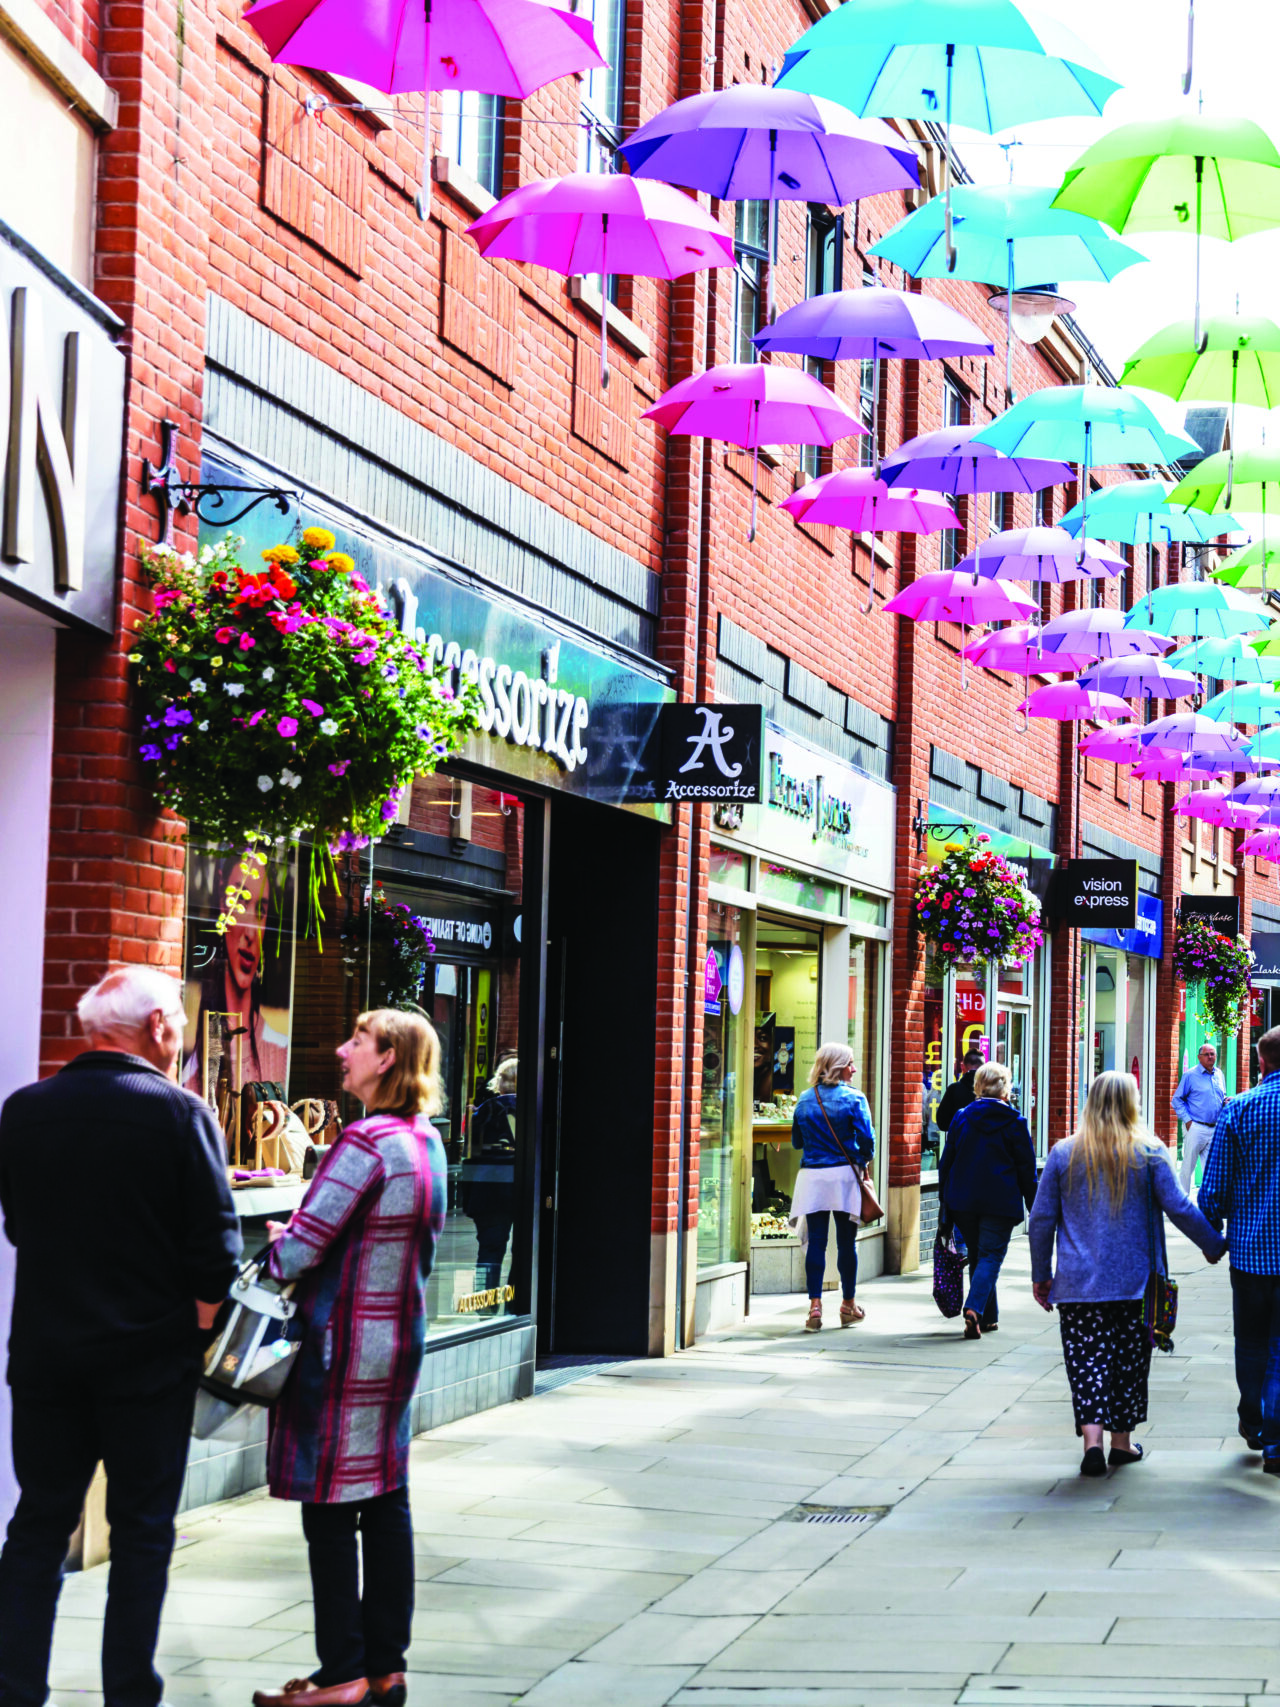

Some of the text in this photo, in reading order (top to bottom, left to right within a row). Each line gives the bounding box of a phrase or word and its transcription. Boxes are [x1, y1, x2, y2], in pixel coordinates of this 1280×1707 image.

[678, 706, 743, 778] A
[664, 779, 755, 799] Accessorize
[1082, 877, 1122, 892] vision
[1074, 894, 1129, 909] express
